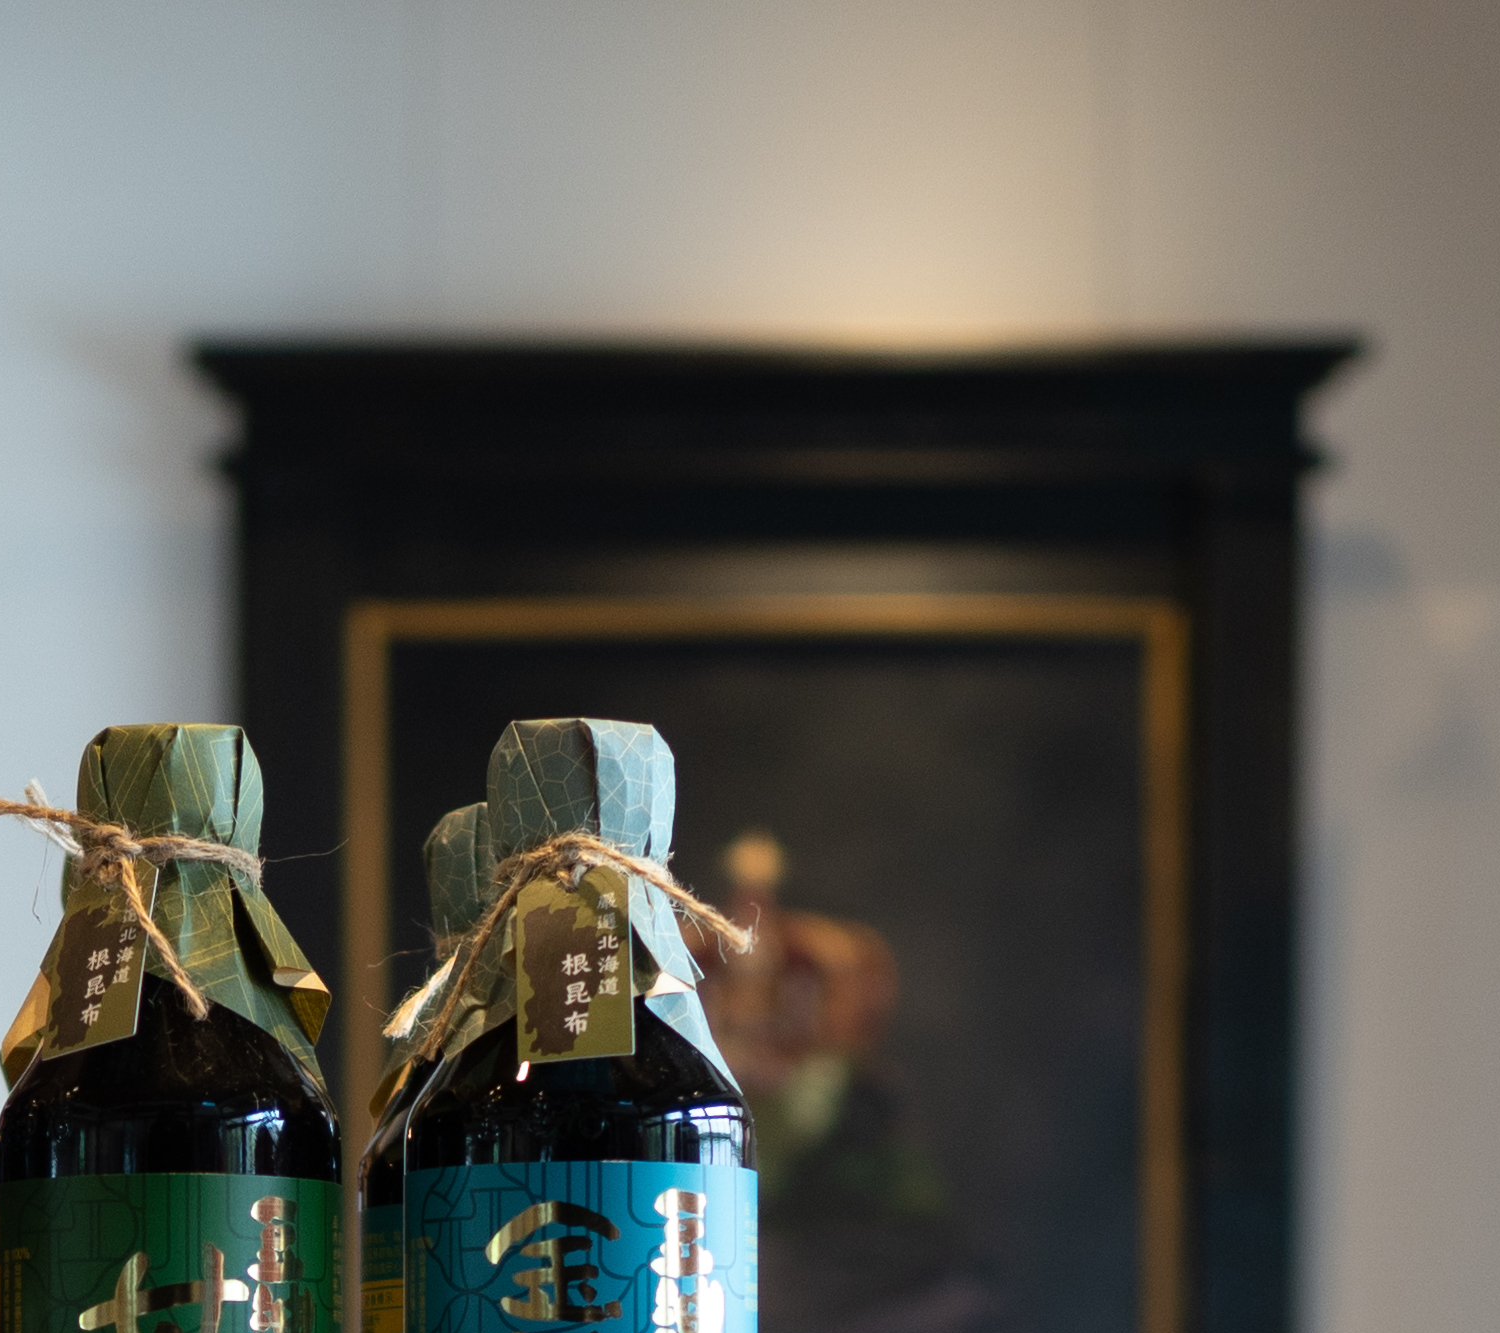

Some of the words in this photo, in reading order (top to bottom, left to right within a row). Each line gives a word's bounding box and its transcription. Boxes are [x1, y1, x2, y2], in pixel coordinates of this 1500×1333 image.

[79, 948, 111, 1027] 根昆布
[560, 953, 593, 1036] 根昆布
